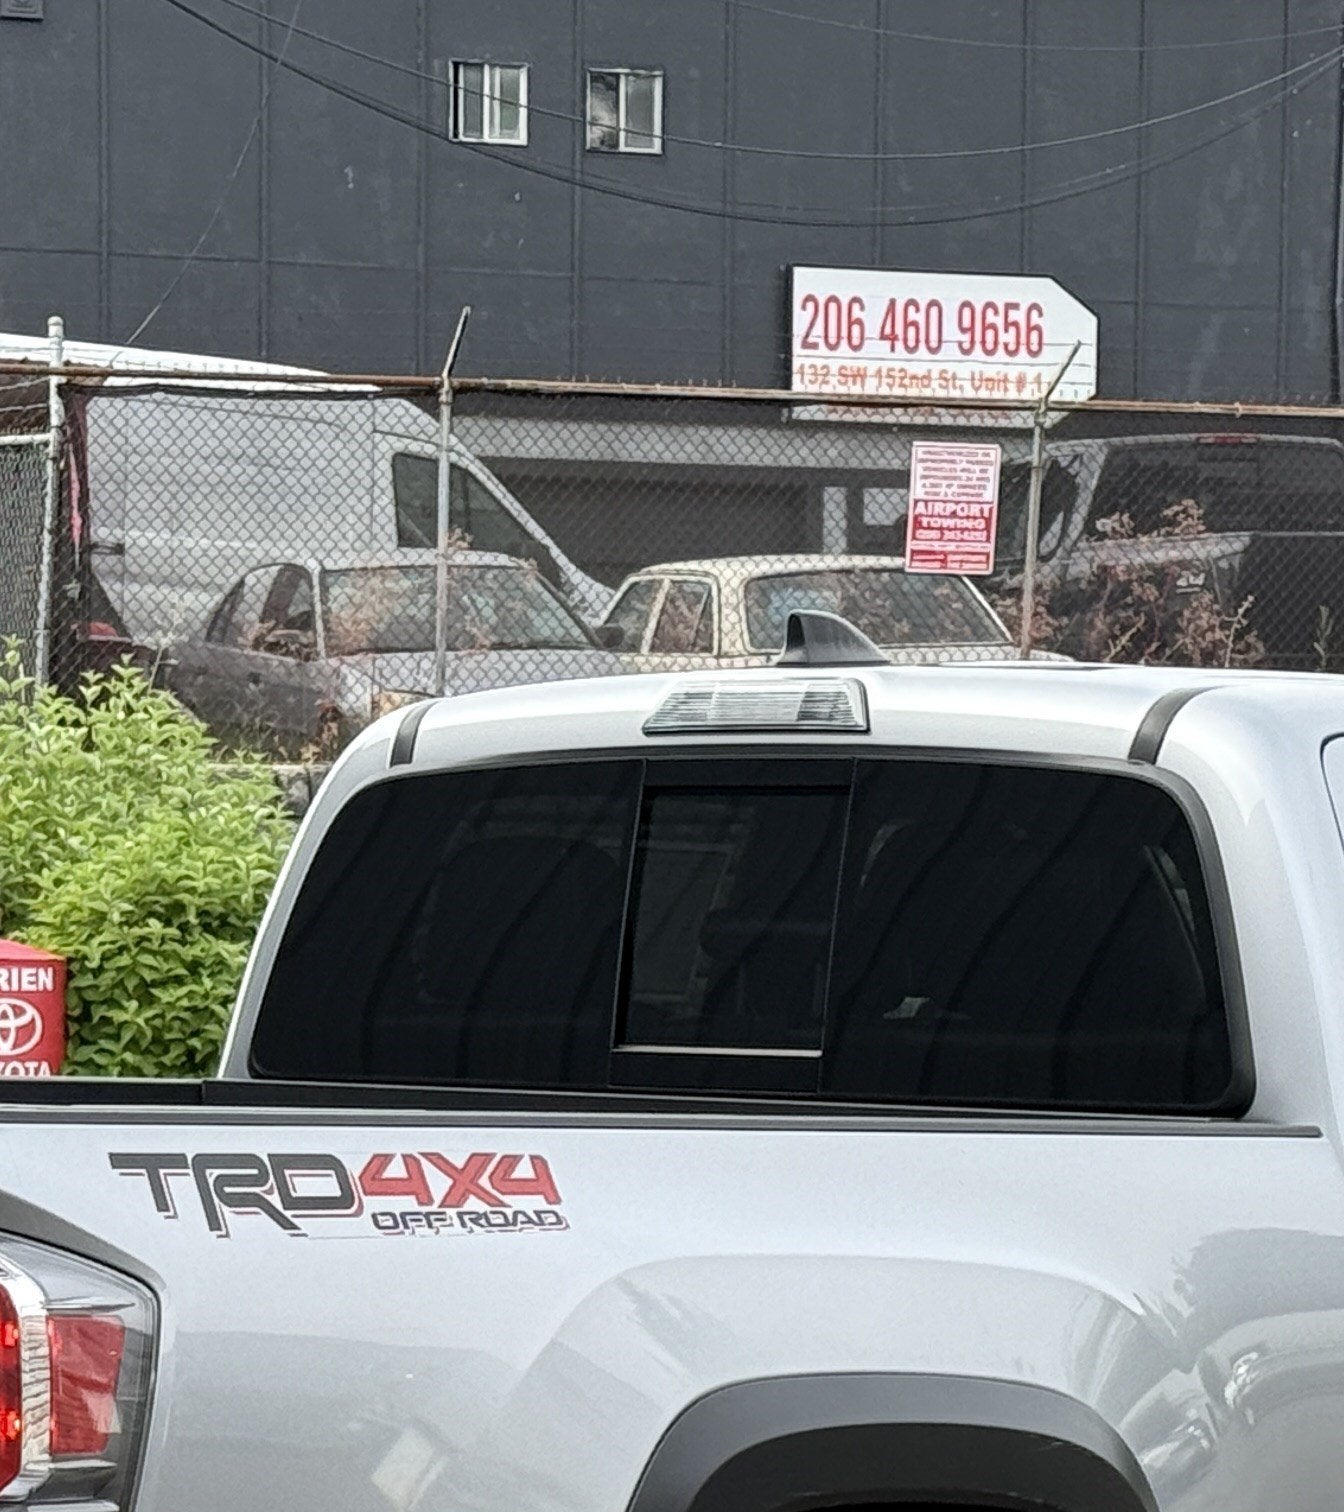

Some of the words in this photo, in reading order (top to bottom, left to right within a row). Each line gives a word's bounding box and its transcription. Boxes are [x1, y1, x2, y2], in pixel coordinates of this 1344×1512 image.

[801, 293, 866, 352] 206
[879, 297, 943, 355] 460
[957, 300, 1044, 358] 9656
[797, 363, 831, 386] 132
[837, 365, 868, 387] SW
[875, 366, 933, 390] 152nd
[970, 370, 1011, 393] Unit
[914, 501, 994, 518] AIRPORT
[108, 1152, 363, 1239] TRD
[371, 1210, 454, 1236] OFF
[458, 1209, 569, 1233] ROAD
